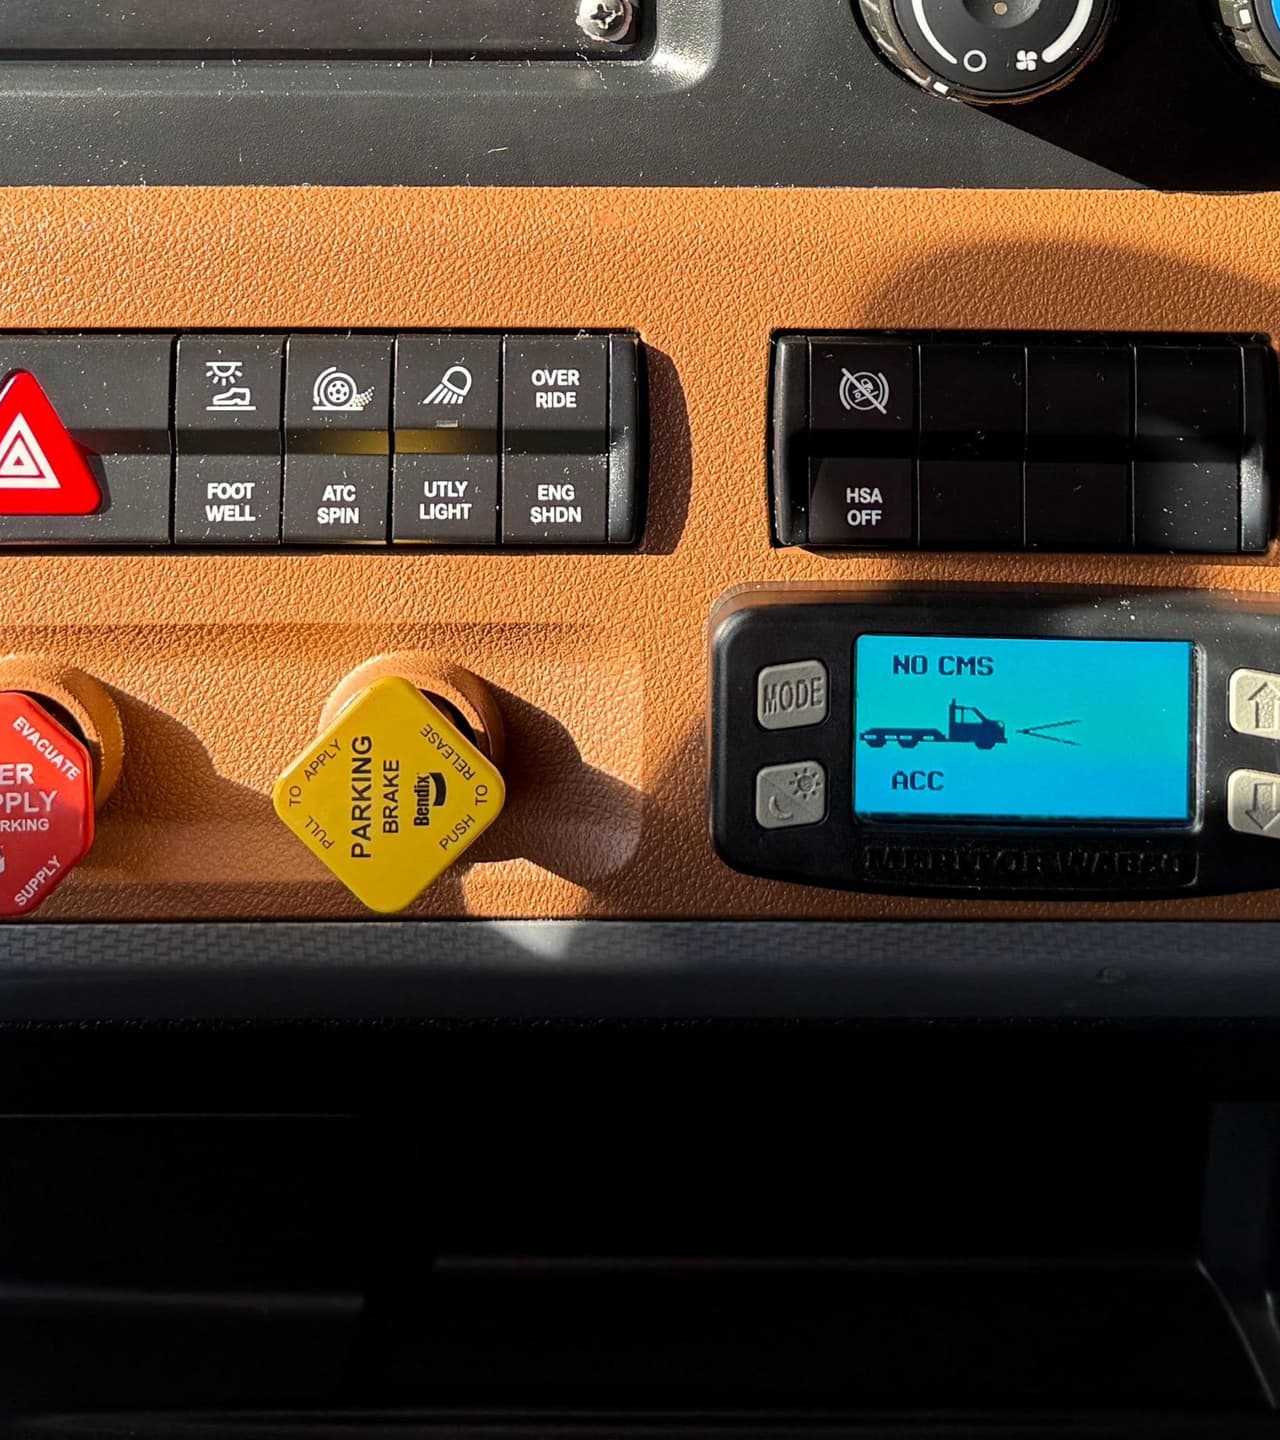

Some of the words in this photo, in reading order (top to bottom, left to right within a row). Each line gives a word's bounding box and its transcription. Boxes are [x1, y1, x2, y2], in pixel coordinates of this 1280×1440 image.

[531, 369, 580, 387] OVER
[535, 392, 577, 409] RIDE
[207, 483, 254, 501] FOOT
[322, 485, 356, 502] ATC
[424, 482, 467, 499] UTLY
[538, 485, 575, 502] ENG
[846, 487, 883, 504] HSA
[205, 504, 255, 522] WELL
[317, 508, 359, 525] SPIN
[420, 503, 472, 520] LIGHT
[530, 506, 582, 524] SHDN
[847, 509, 882, 526] OFF
[892, 655, 928, 676] NO
[937, 655, 995, 678] CMS
[762, 676, 824, 713] MODE
[12, 716, 81, 781] EVACUATE
[420, 724, 476, 781] RELEASE
[303, 738, 342, 781] APPLY
[892, 771, 945, 792] ACC
[289, 785, 302, 807] TO
[351, 736, 373, 858] PARKING
[383, 760, 400, 834] BRAKE
[414, 775, 430, 826] Bendix
[475, 784, 488, 806] TO
[304, 816, 335, 849] PULL
[439, 814, 475, 851] PUSH
[15, 855, 62, 906] SUPPLY
